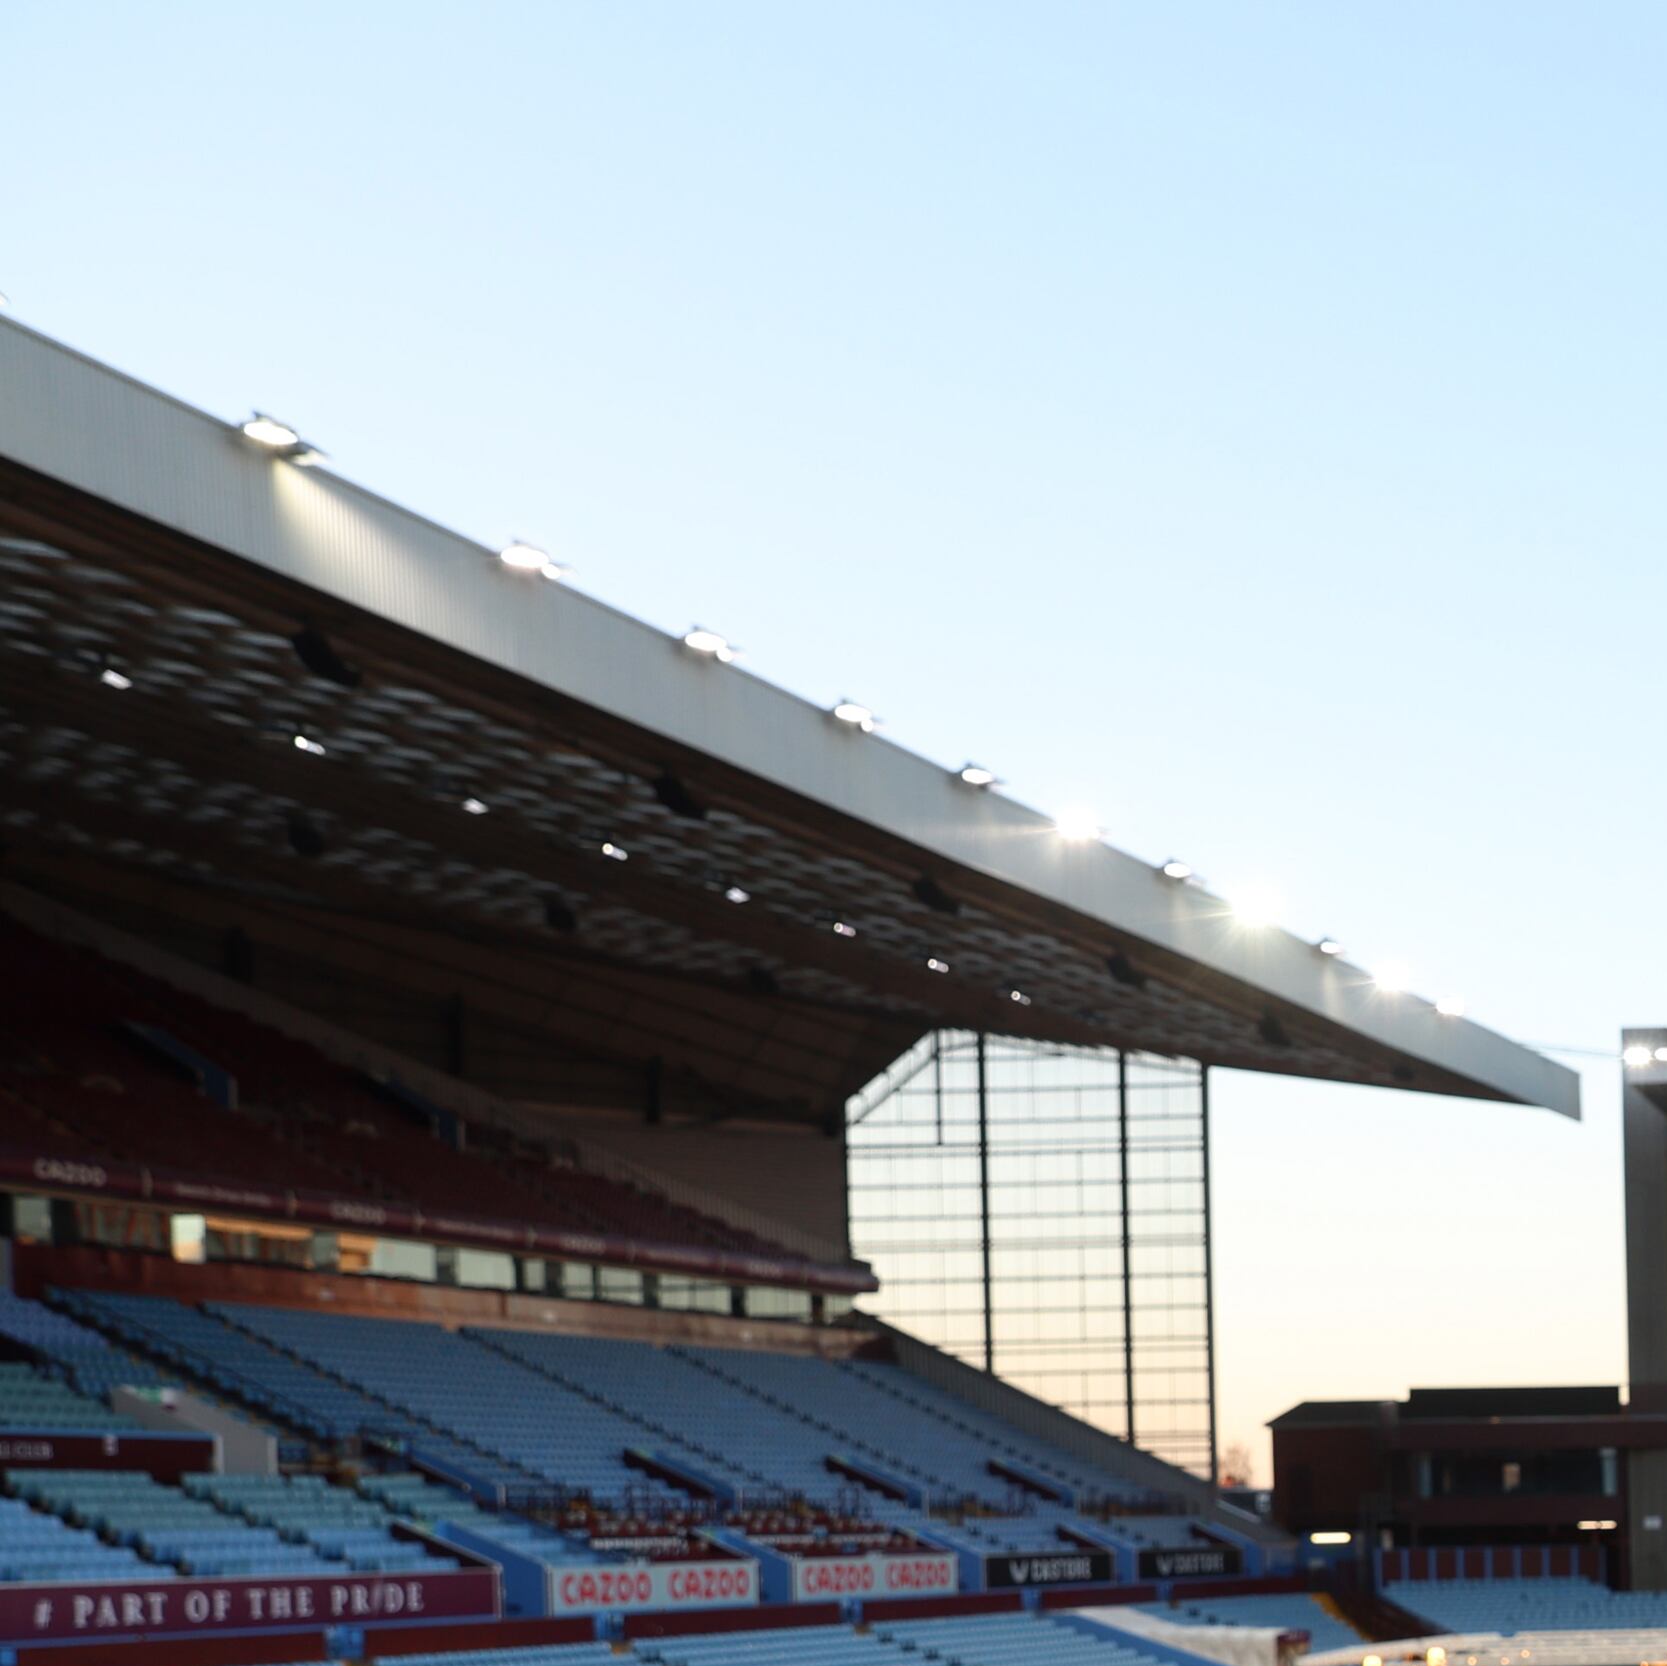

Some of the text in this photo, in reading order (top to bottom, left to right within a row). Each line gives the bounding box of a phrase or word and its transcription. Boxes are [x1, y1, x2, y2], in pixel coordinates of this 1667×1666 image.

[33, 1157, 107, 1187] CAZOO
[560, 1567, 750, 1606] CAZOO CAZOO
[803, 1561, 951, 1594] CAZOO CAZOO
[72, 1591, 168, 1628] PART
[184, 1588, 232, 1624] OF
[249, 1586, 314, 1619] THE
